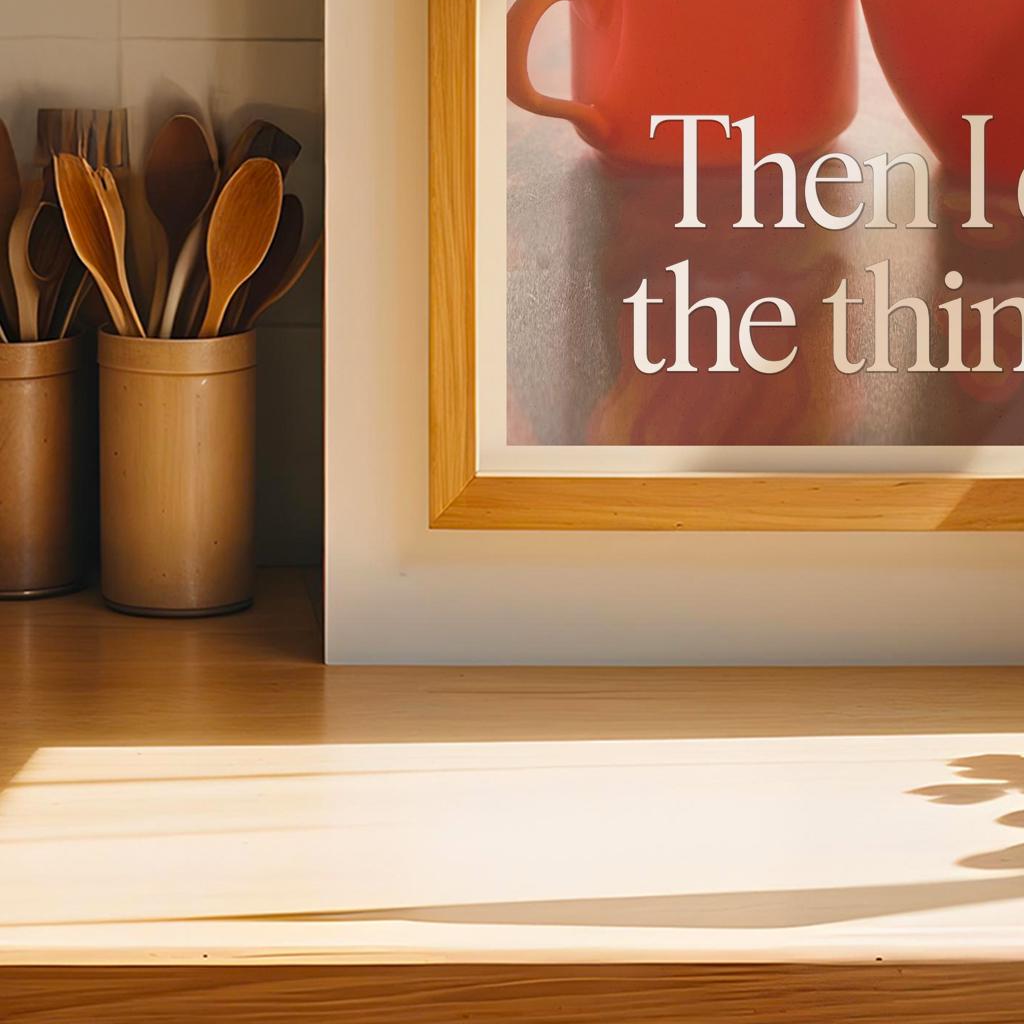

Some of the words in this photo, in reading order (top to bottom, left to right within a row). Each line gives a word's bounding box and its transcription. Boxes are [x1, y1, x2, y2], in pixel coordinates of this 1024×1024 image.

[649, 114, 937, 230] Then
[961, 114, 994, 230] I
[622, 259, 798, 374] the
